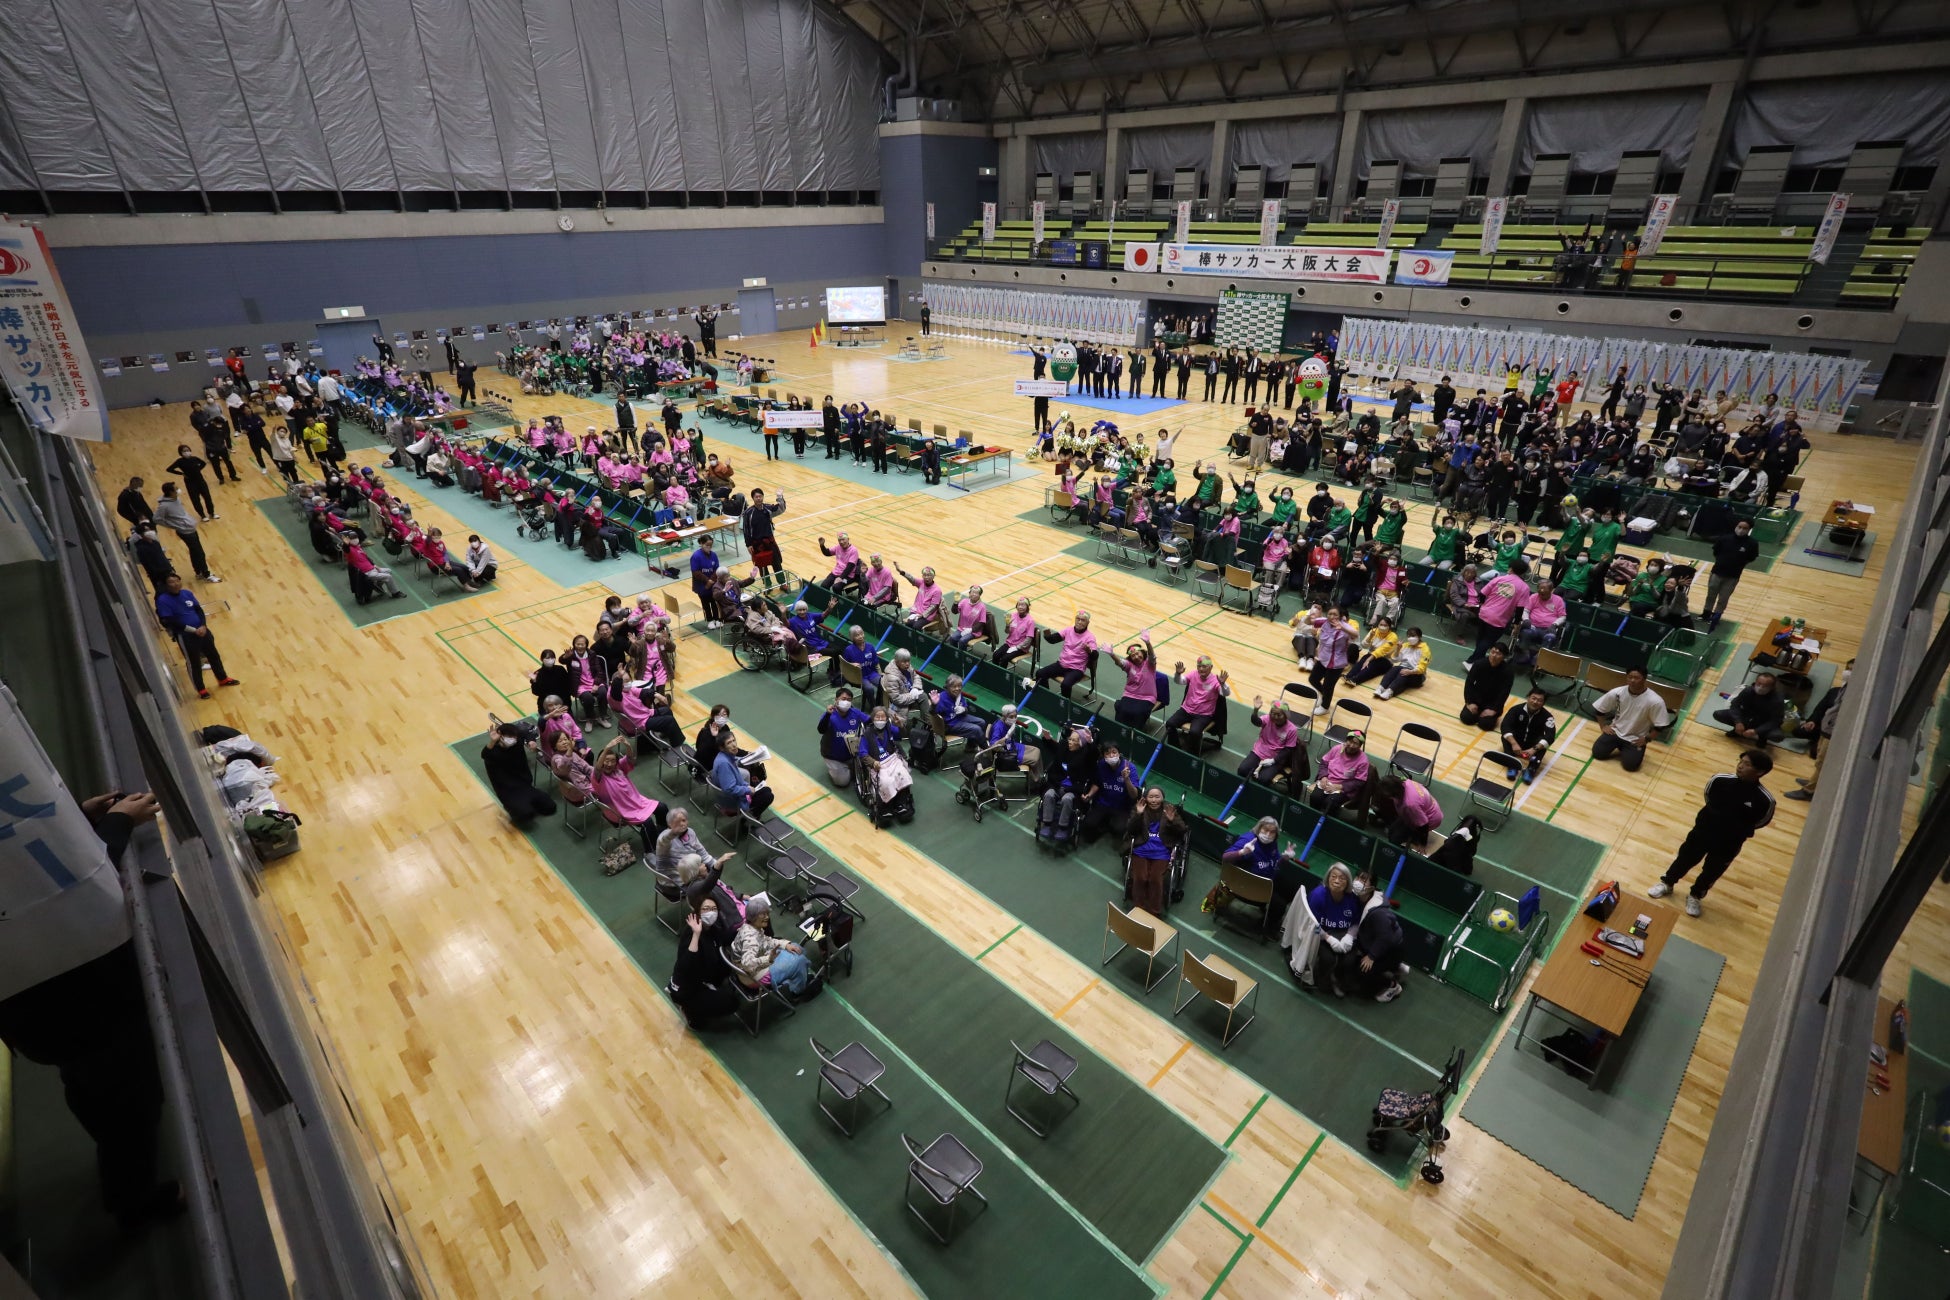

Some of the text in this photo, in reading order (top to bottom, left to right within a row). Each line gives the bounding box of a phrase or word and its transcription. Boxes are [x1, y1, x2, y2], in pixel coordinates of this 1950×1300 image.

[1199, 251, 1361, 273] 棒サッカー大阪大会
[0, 306, 55, 424] 棒サッカー
[43, 302, 90, 407] 挑戦が日本を元気にする
